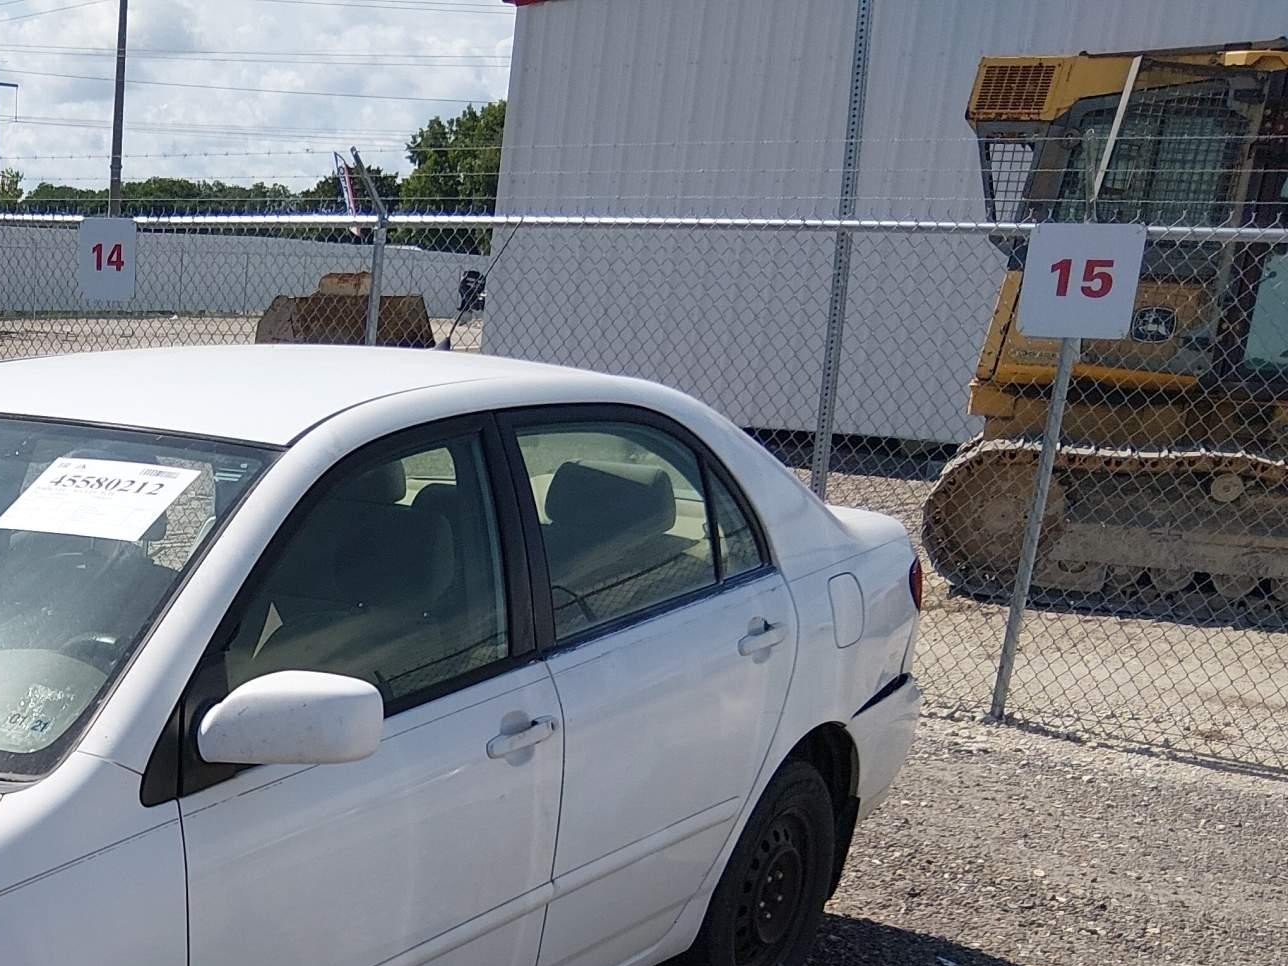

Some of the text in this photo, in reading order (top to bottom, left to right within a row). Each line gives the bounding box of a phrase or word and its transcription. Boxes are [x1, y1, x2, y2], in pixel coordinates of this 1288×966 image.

[92, 243, 125, 272] 14
[1050, 258, 1115, 298] 15
[49, 474, 165, 496] 45580212
[31, 719, 50, 732] 21
